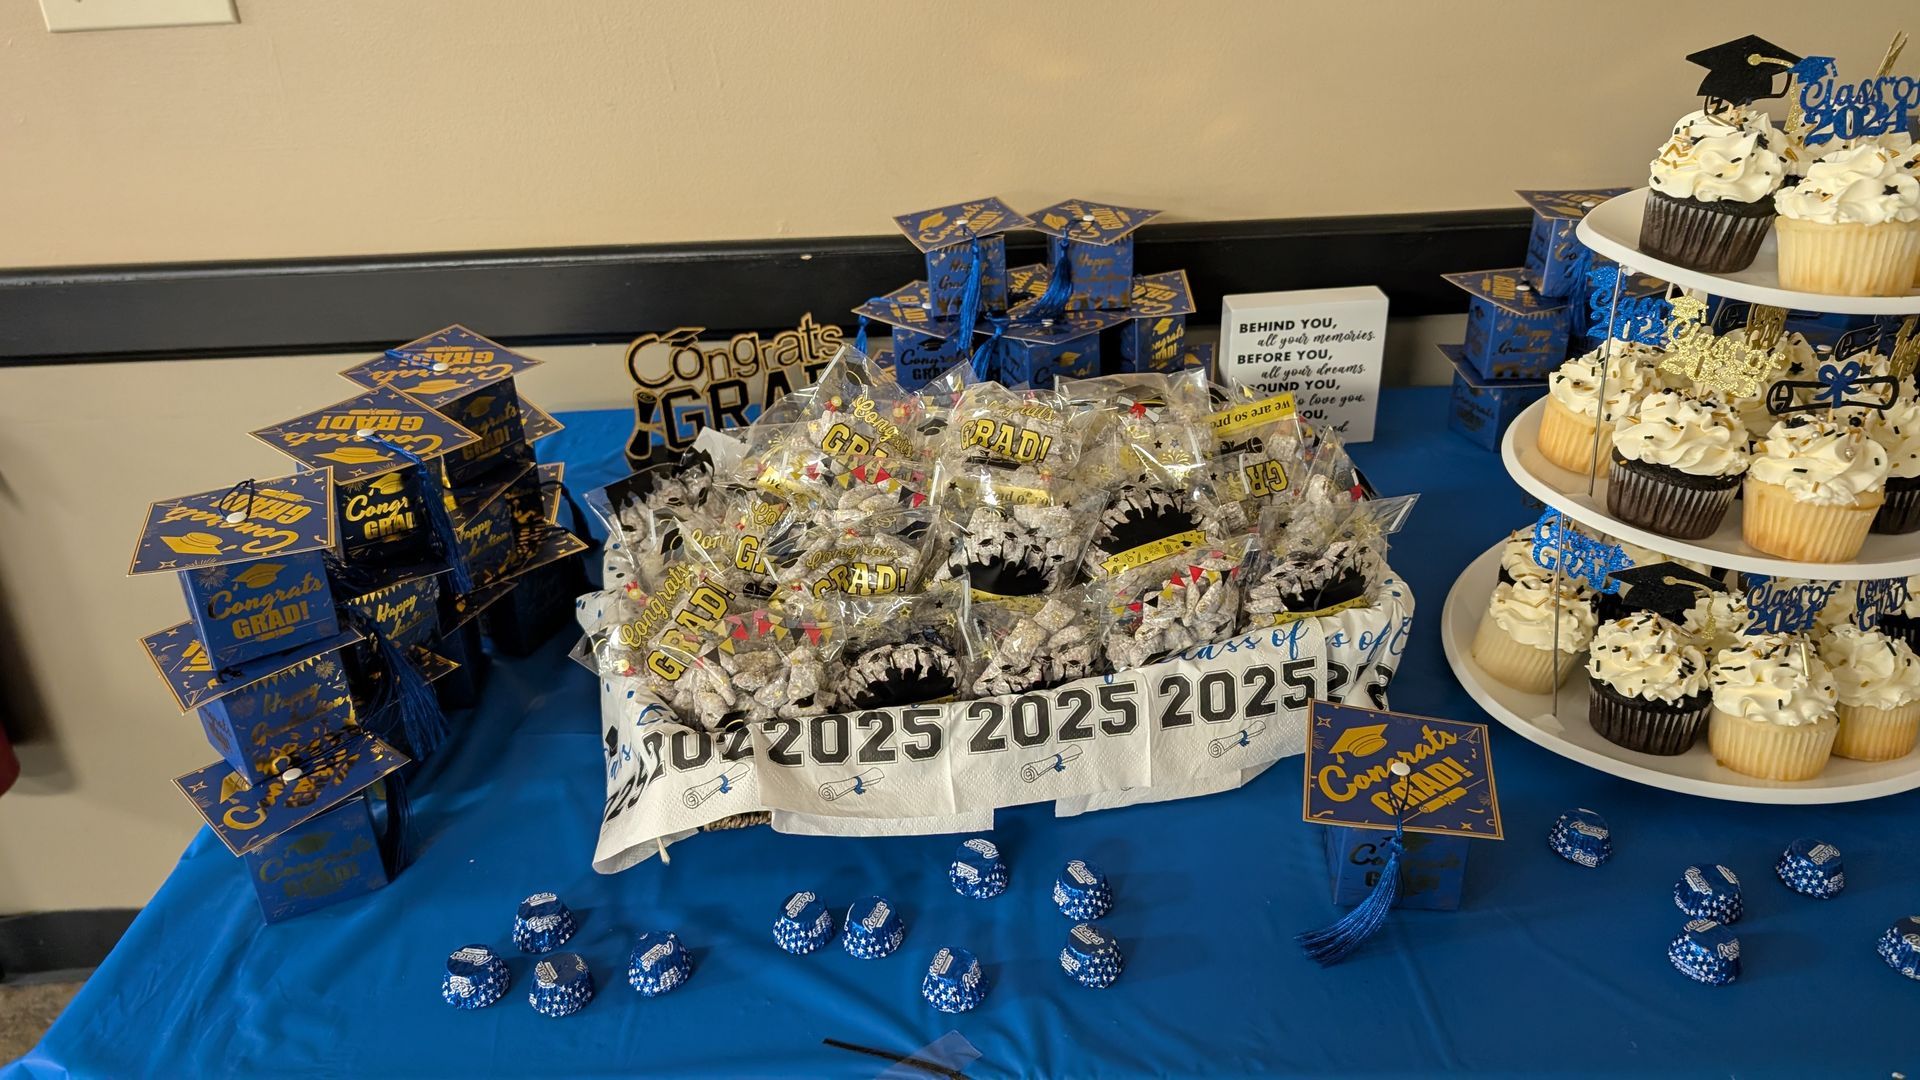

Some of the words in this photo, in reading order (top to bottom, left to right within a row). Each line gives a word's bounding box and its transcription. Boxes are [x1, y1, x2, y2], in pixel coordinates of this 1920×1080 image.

[1799, 77, 1896, 114] Class
[1893, 76, 1920, 110] o
[1803, 101, 1909, 147] 2024
[1239, 320, 1295, 334] BEHIND
[1301, 318, 1337, 330] YOU,
[1257, 333, 1278, 347] all
[1279, 332, 1310, 349] your
[1313, 330, 1376, 344] memories.
[625, 312, 844, 389] Congrats
[1237, 351, 1291, 365] BEFORE
[1297, 349, 1333, 361] YOU,
[1250, 381, 1300, 394] OUND
[1305, 379, 1341, 391] YOU,
[1261, 365, 1281, 379] all
[1283, 365, 1313, 382] your
[1316, 363, 1366, 376] dreams.
[657, 361, 830, 453] GRA
[1234, 411, 1248, 422] so
[1251, 405, 1271, 417] are
[1274, 400, 1291, 411] we
[1310, 394, 1335, 406] love
[316, 415, 424, 431] GRAD!
[960, 419, 1052, 465] GRAD!
[1245, 458, 1289, 499] GR
[345, 493, 409, 522] Congr
[208, 571, 326, 621] Congrats
[812, 561, 908, 600] GRAD!
[1746, 583, 1810, 609] Class
[1808, 580, 1842, 612] of
[232, 600, 311, 641] GRAD!
[376, 594, 418, 623] Happy
[618, 562, 691, 649] Congrats
[1743, 604, 1818, 637] 2024
[647, 577, 737, 682] GRAD!
[1271, 619, 1310, 661] of
[1157, 656, 1318, 731] 2025
[761, 707, 945, 768] 2025
[966, 680, 1140, 756] 2025
[642, 726, 755, 785] 202
[1370, 755, 1475, 816] GRAD!
